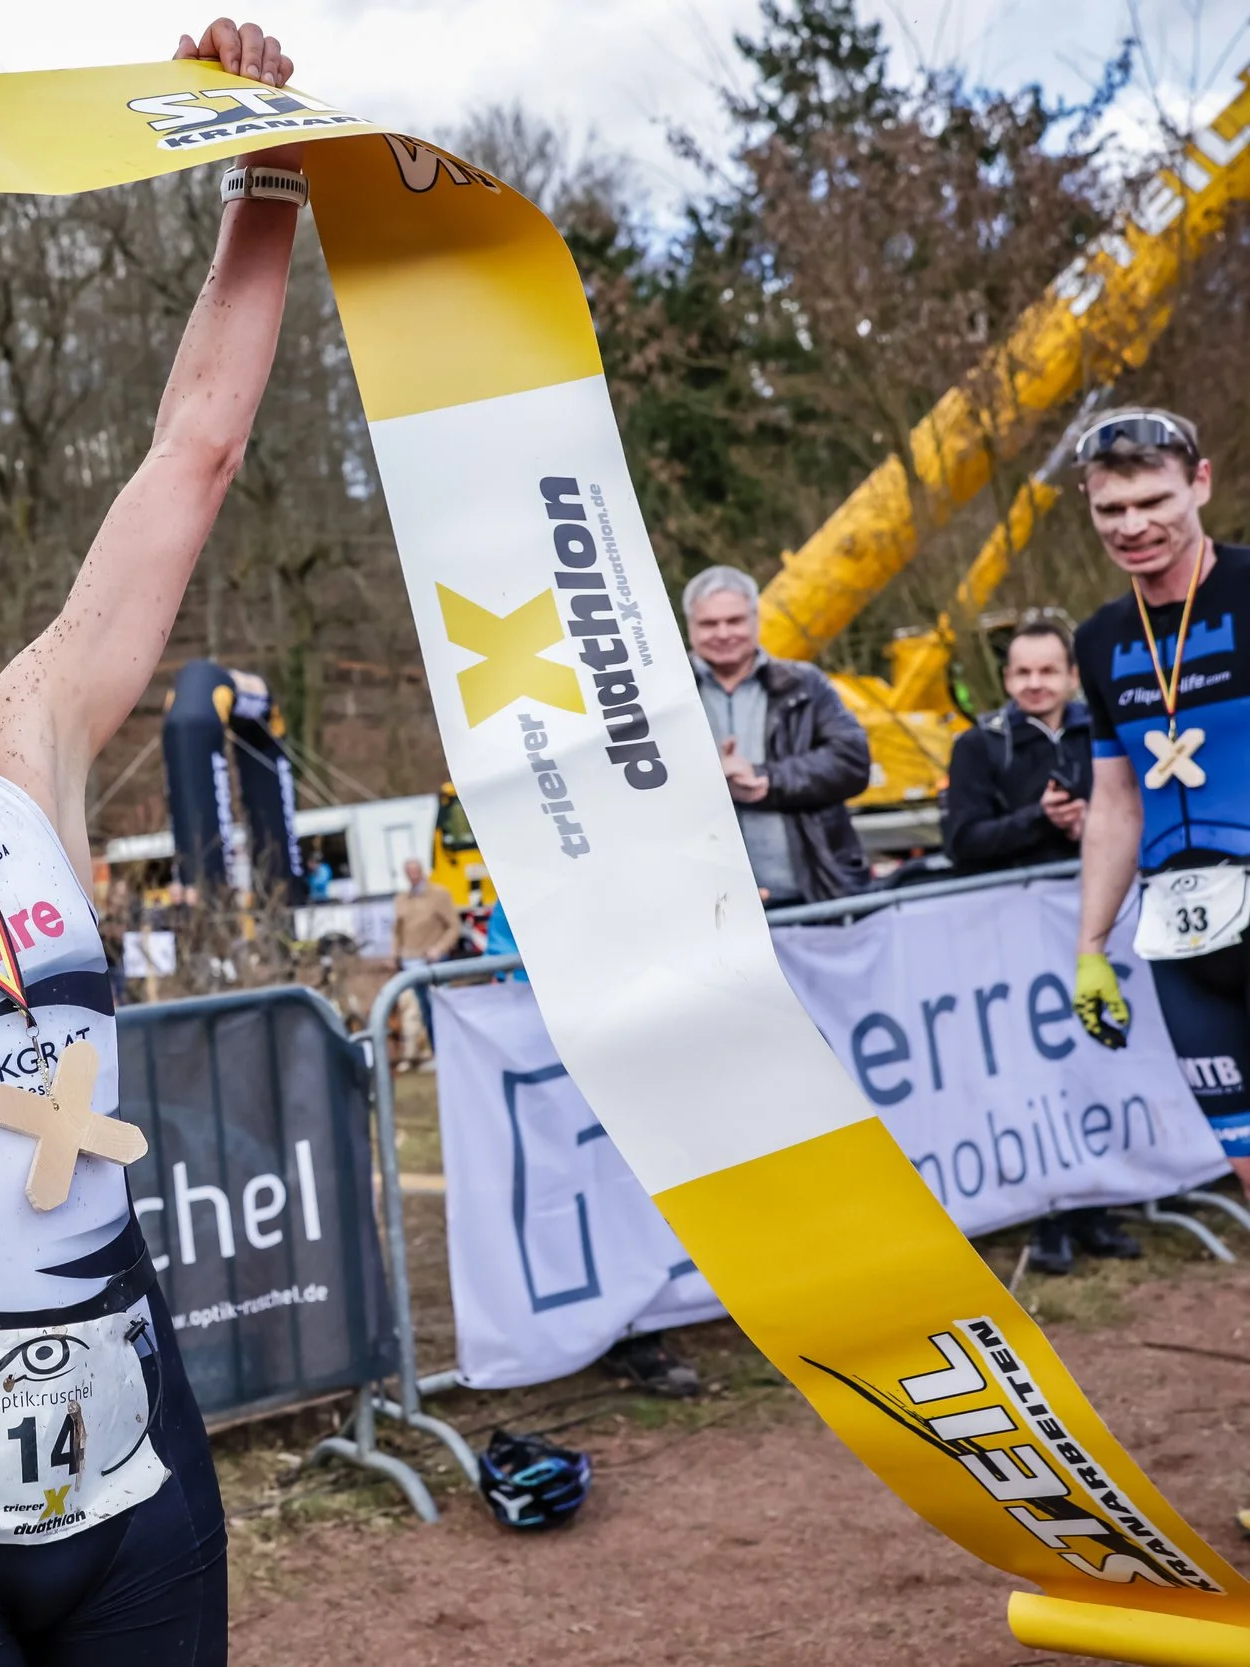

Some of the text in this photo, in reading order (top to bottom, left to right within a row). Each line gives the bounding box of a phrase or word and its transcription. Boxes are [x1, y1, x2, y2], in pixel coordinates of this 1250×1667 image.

[164, 115, 374, 148] KRANAR
[539, 476, 668, 790] duathlon
[589, 483, 653, 667] www.X-duathlon.de
[517, 713, 590, 859] trierer
[1177, 906, 1208, 933] 33
[851, 962, 1134, 1106] erre
[3, 1502, 44, 1513] trierer
[7, 1413, 86, 1484] 14
[898, 1331, 1182, 1588] STEIL
[967, 1320, 1221, 1593] KRANARBEITEN
[13, 1510, 87, 1535] duathlon
